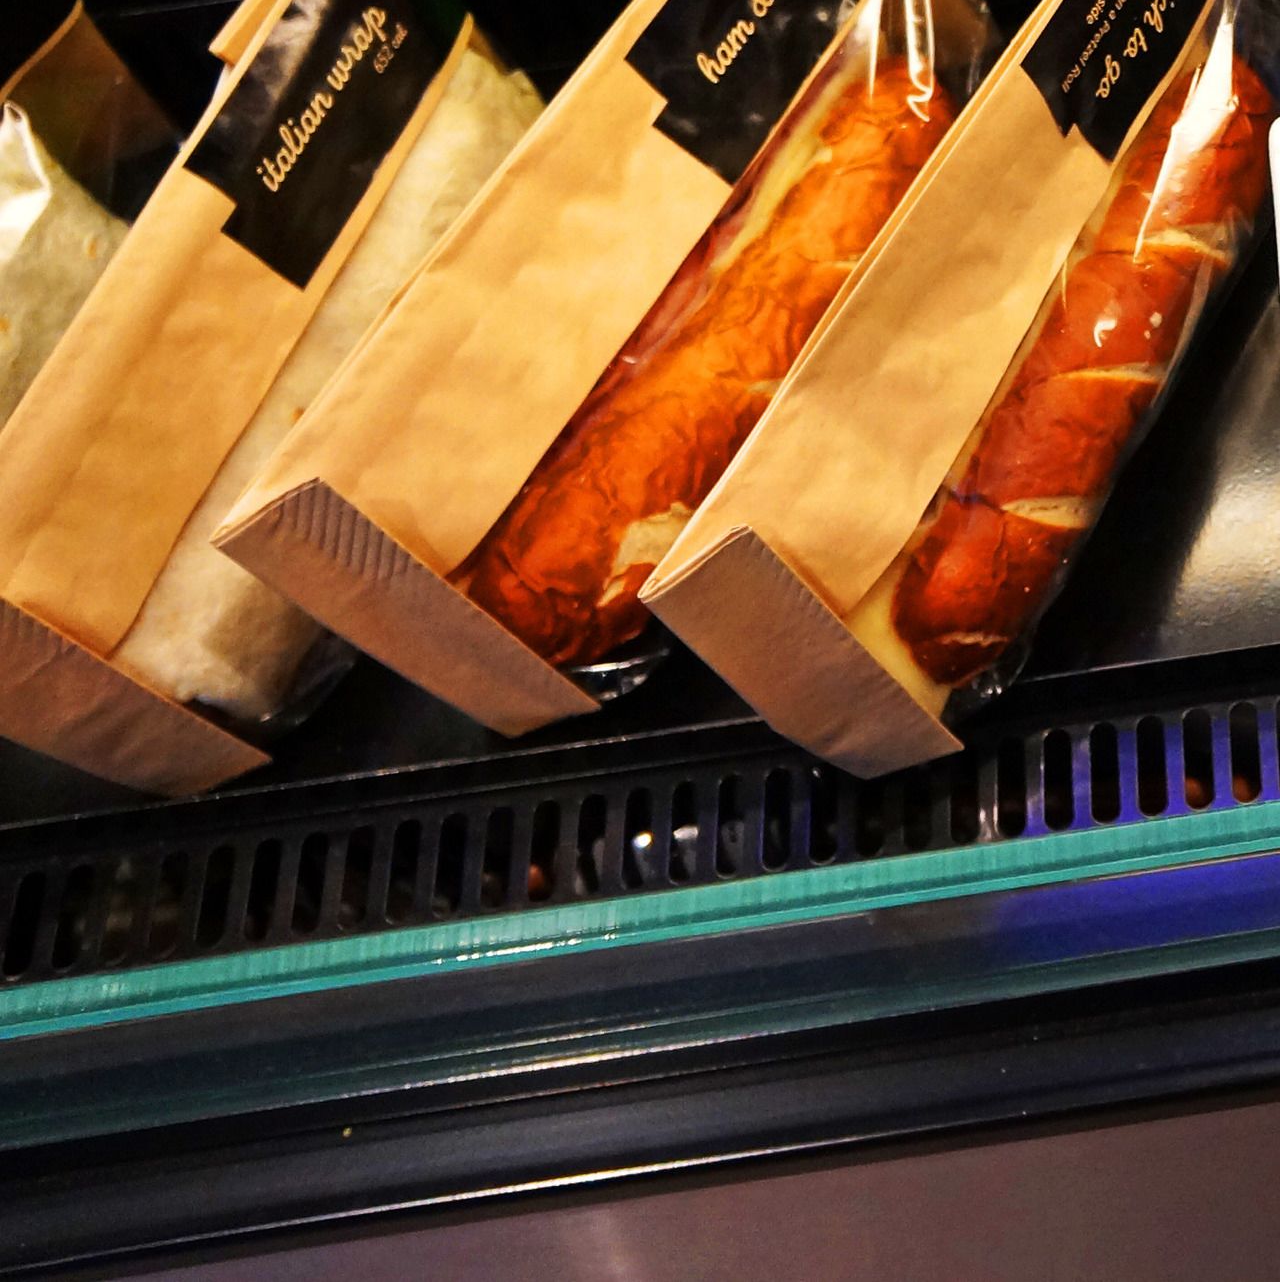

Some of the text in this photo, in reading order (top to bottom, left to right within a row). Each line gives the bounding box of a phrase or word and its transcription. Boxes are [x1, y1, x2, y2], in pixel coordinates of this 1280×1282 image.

[373, 46, 395, 74] 652
[696, 18, 756, 84] ham
[1123, 27, 1149, 59] to
[256, 5, 388, 193] italian wrap
[1095, 54, 1121, 99] go
